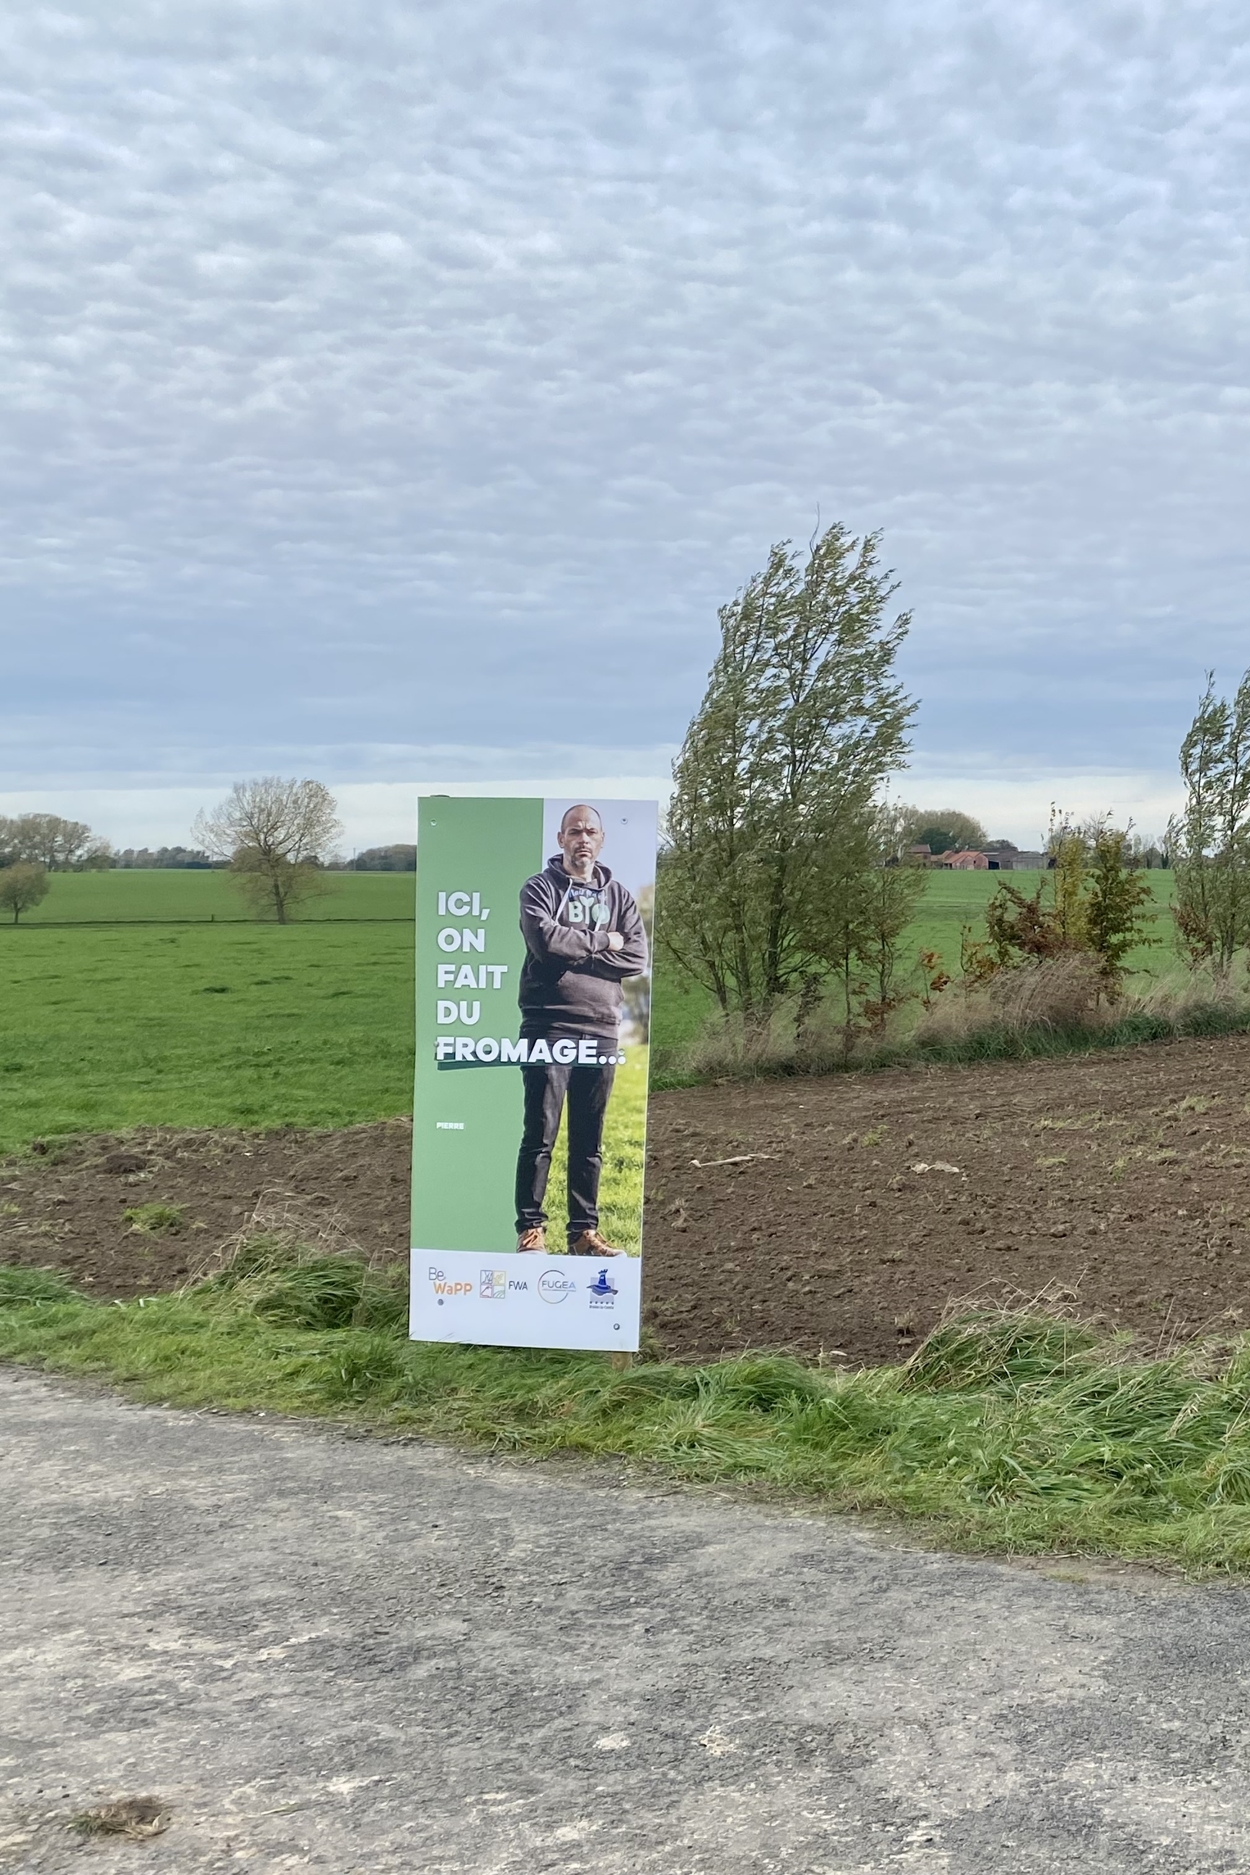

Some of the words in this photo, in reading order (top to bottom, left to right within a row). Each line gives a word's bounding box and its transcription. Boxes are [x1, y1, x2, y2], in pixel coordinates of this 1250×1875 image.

[437, 891, 490, 920] ICI,
[437, 928, 486, 953] ON
[437, 964, 508, 989] FAIT
[436, 1000, 481, 1025] DU
[436, 1122, 464, 1130] PIERRE
[428, 1267, 446, 1281] Be
[433, 1282, 473, 1295] WaPP
[508, 1281, 528, 1291] FWA
[541, 1280, 576, 1289] FUGEA
